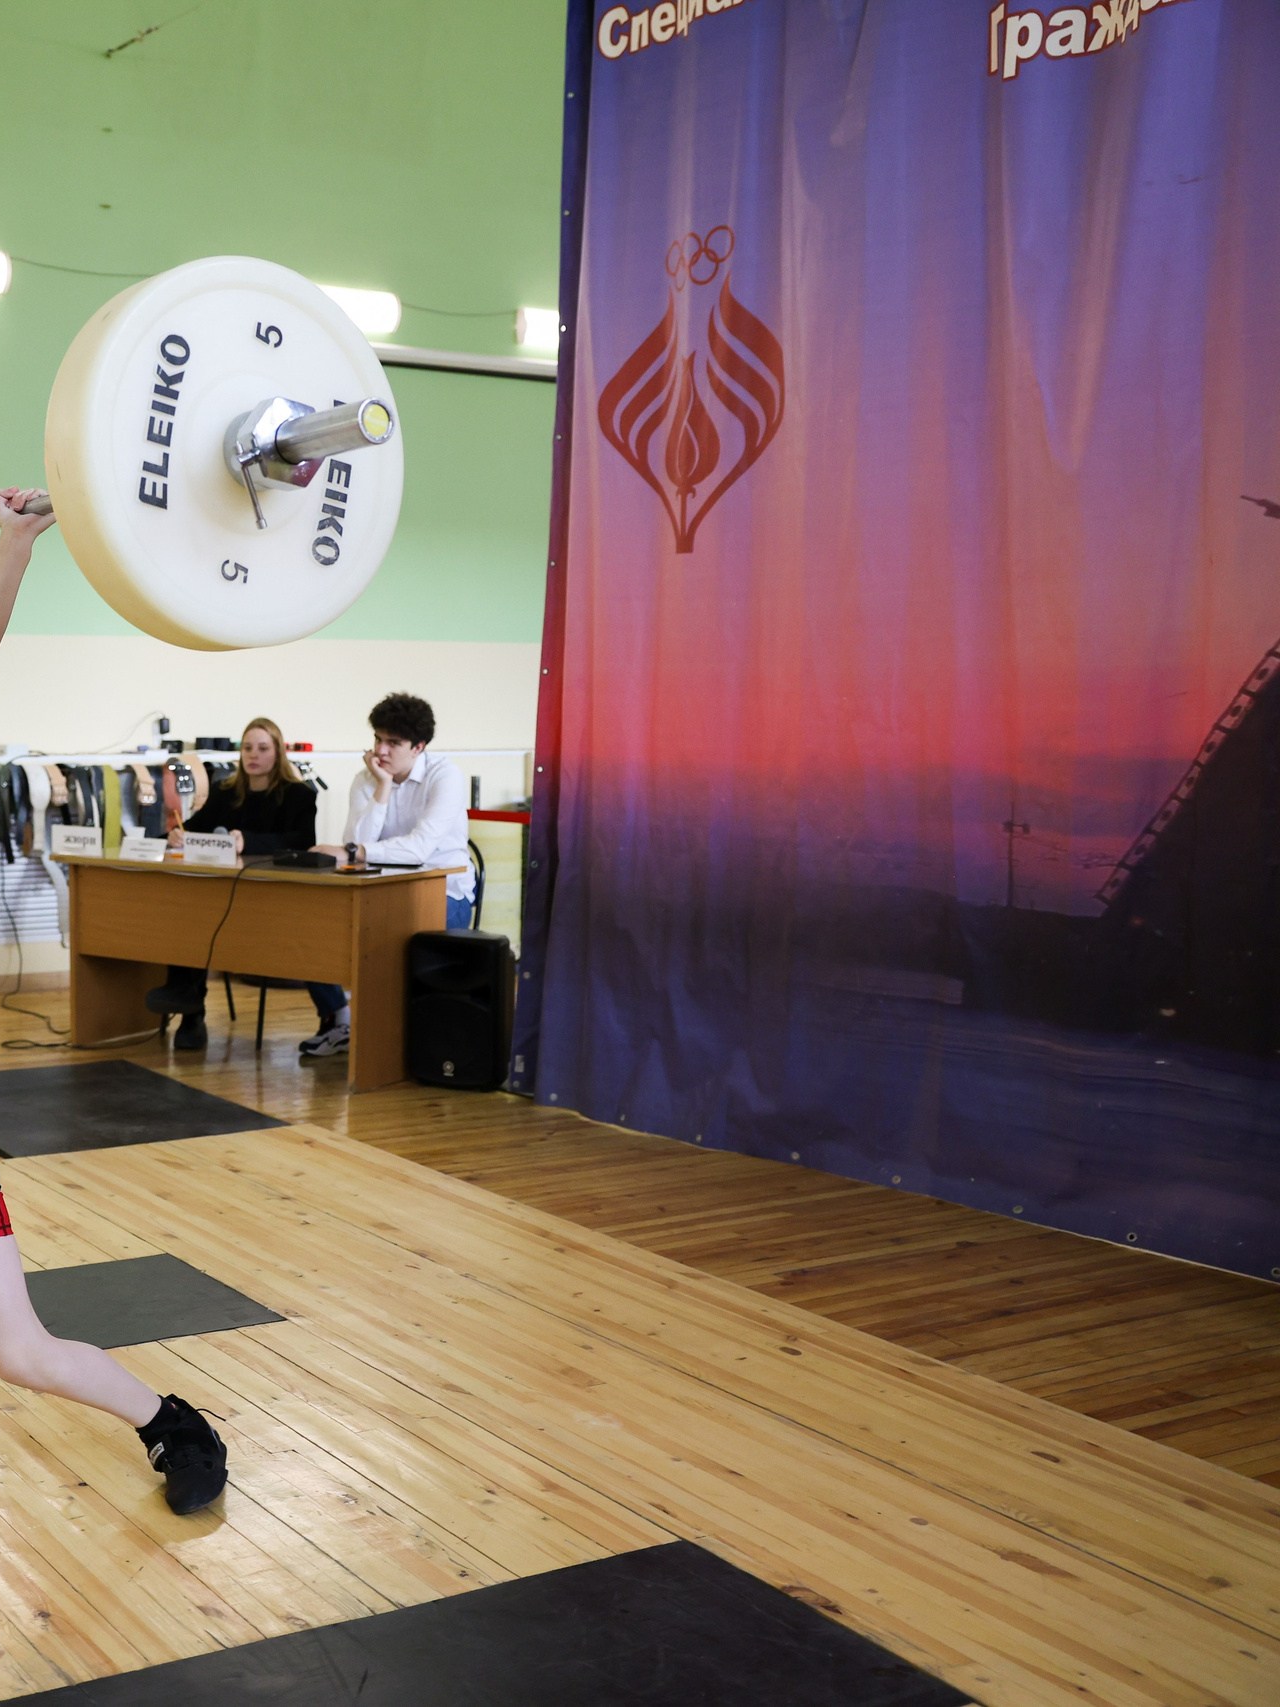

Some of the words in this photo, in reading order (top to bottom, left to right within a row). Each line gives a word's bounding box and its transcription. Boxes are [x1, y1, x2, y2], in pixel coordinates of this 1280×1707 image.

[988, 0, 1172, 80] Гражд
[255, 321, 283, 349] 5
[137, 333, 191, 511] ELEIKO
[311, 398, 353, 567] EIKO
[220, 558, 249, 585] 5
[185, 837, 233, 849] секретарь
